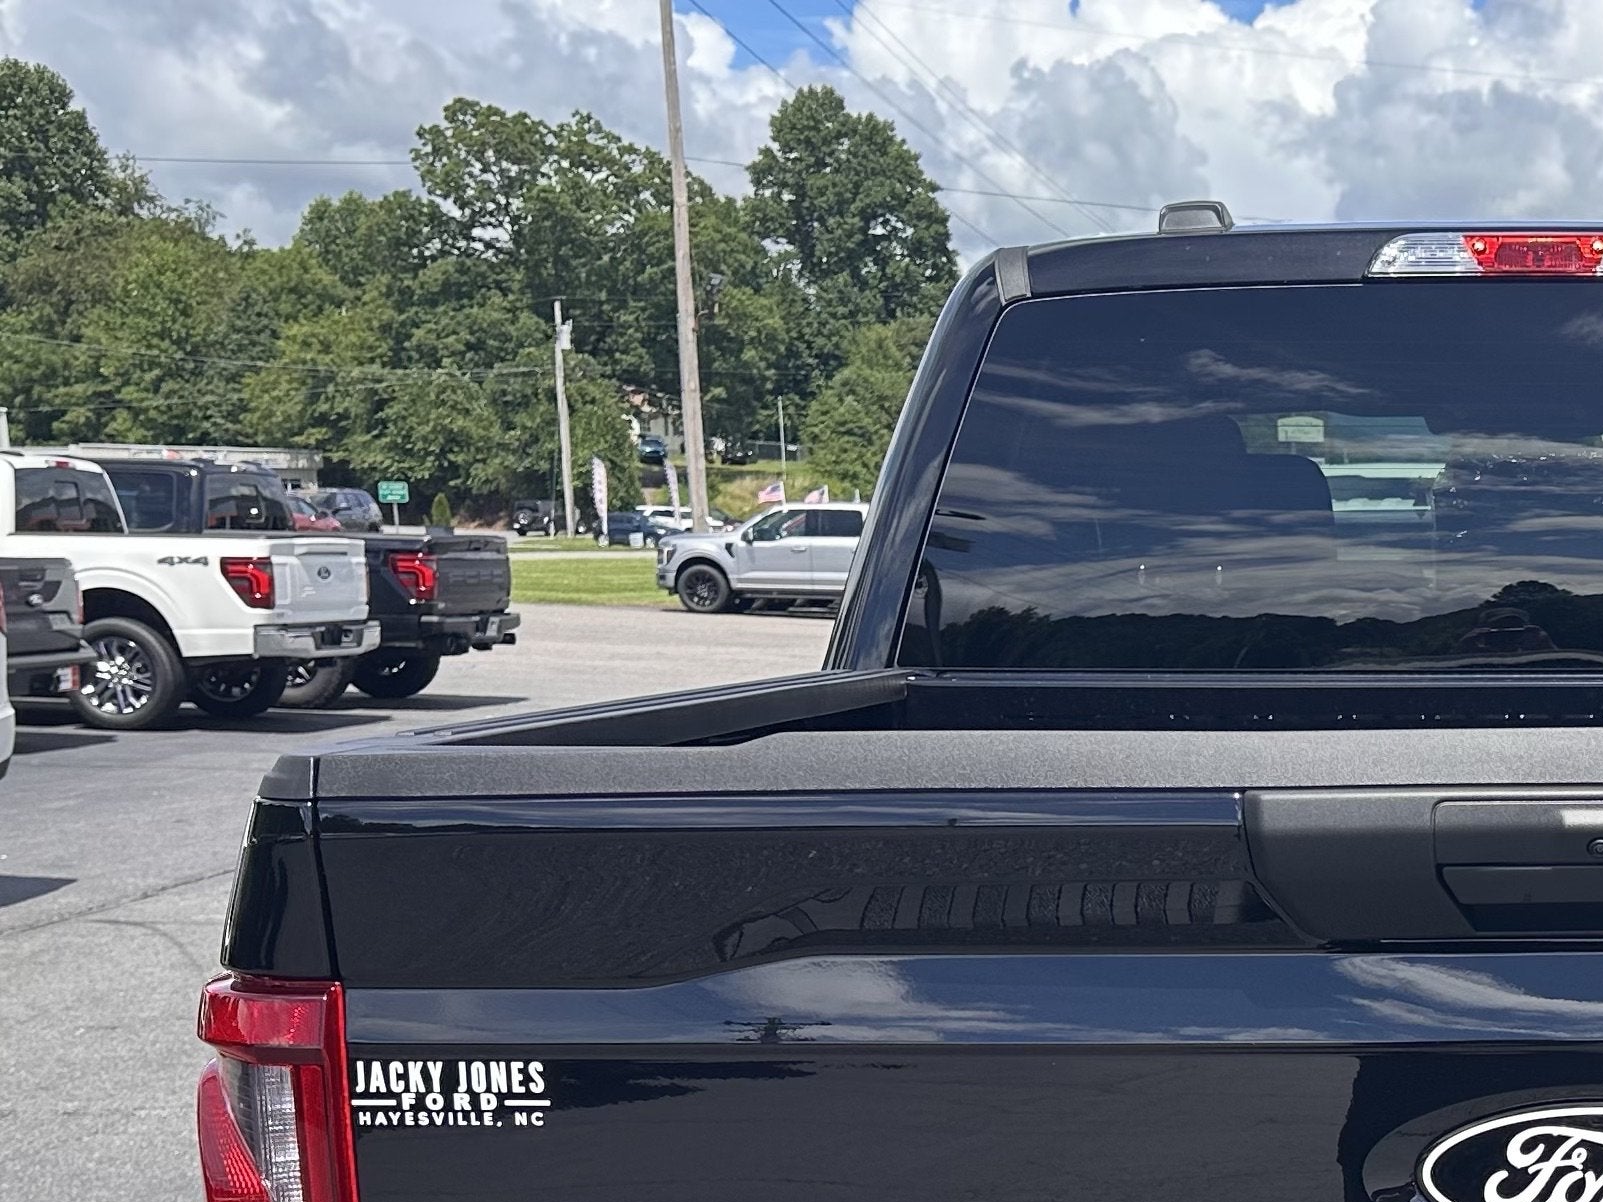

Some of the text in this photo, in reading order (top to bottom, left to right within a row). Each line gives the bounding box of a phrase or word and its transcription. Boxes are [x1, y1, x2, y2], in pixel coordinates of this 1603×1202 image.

[355, 1060, 546, 1094] JACKY JONES
[401, 1092, 498, 1111] FORD
[358, 1111, 545, 1127] HAYESVILLE, NC
